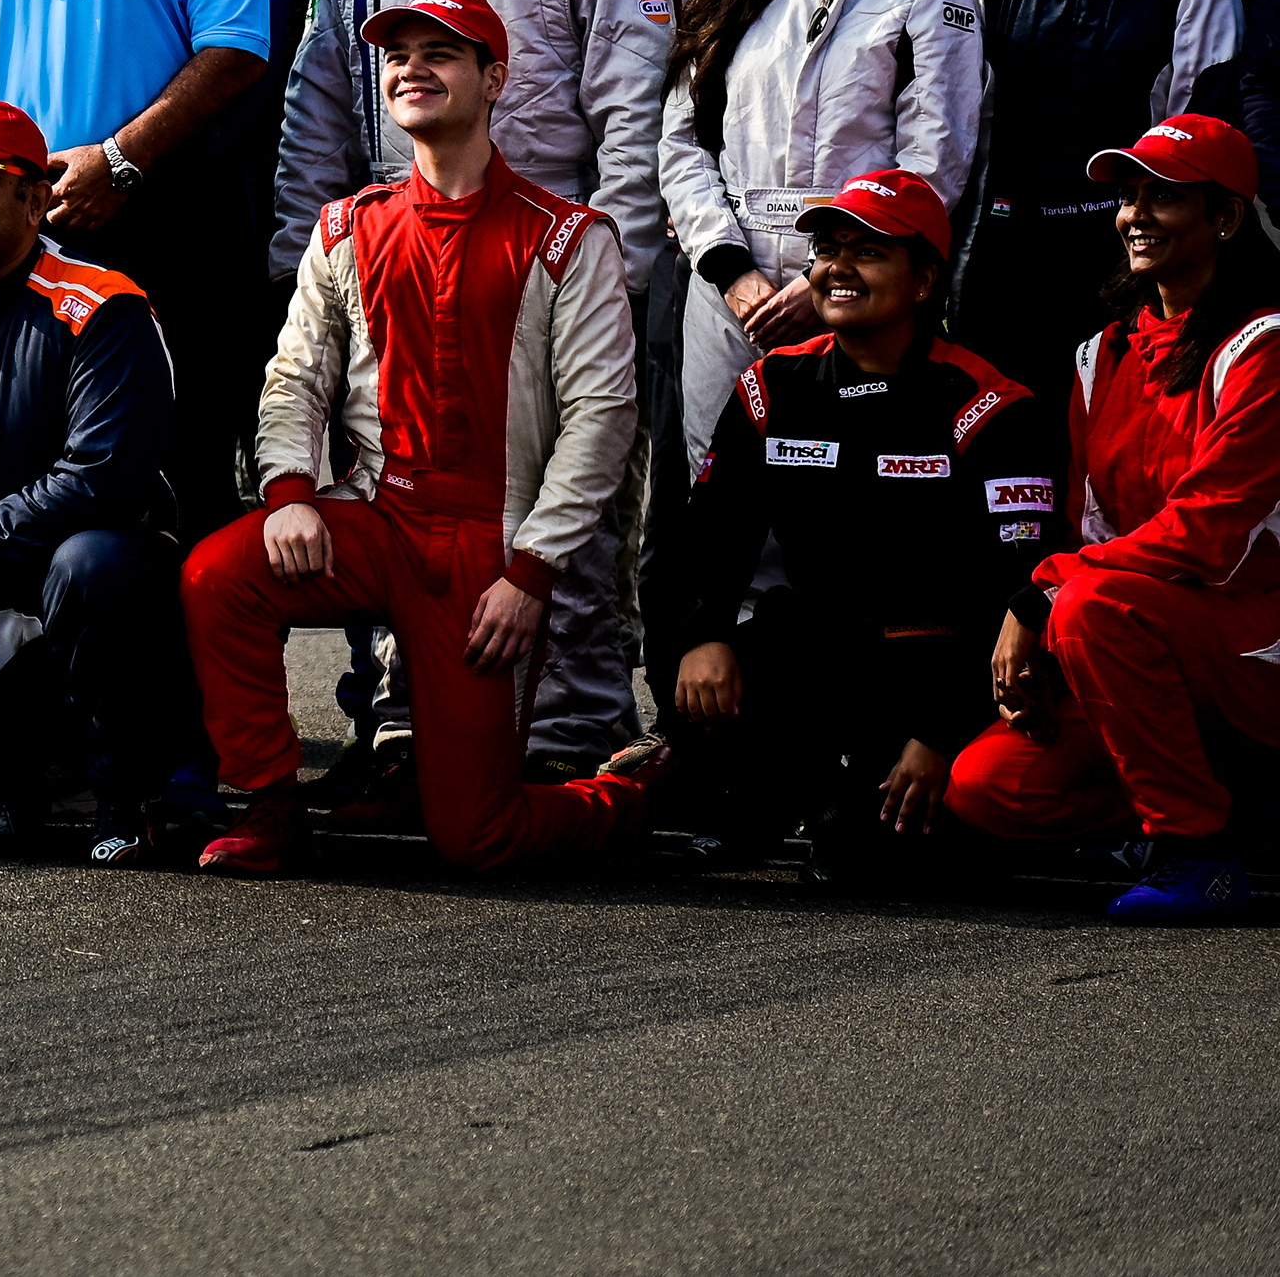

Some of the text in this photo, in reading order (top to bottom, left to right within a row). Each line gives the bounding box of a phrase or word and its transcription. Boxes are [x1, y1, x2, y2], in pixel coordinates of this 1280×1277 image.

[943, 7, 974, 28] OMP
[766, 203, 798, 213] DIANA
[1041, 205, 1077, 216] Tarushi
[1080, 199, 1115, 213] Vikram
[545, 212, 587, 263] sparco
[60, 297, 91, 320] OMP
[740, 370, 764, 420] sparco
[839, 382, 888, 398] sparco
[953, 391, 999, 442] sparco
[776, 441, 828, 459] fmsci
[881, 460, 947, 474] MRF
